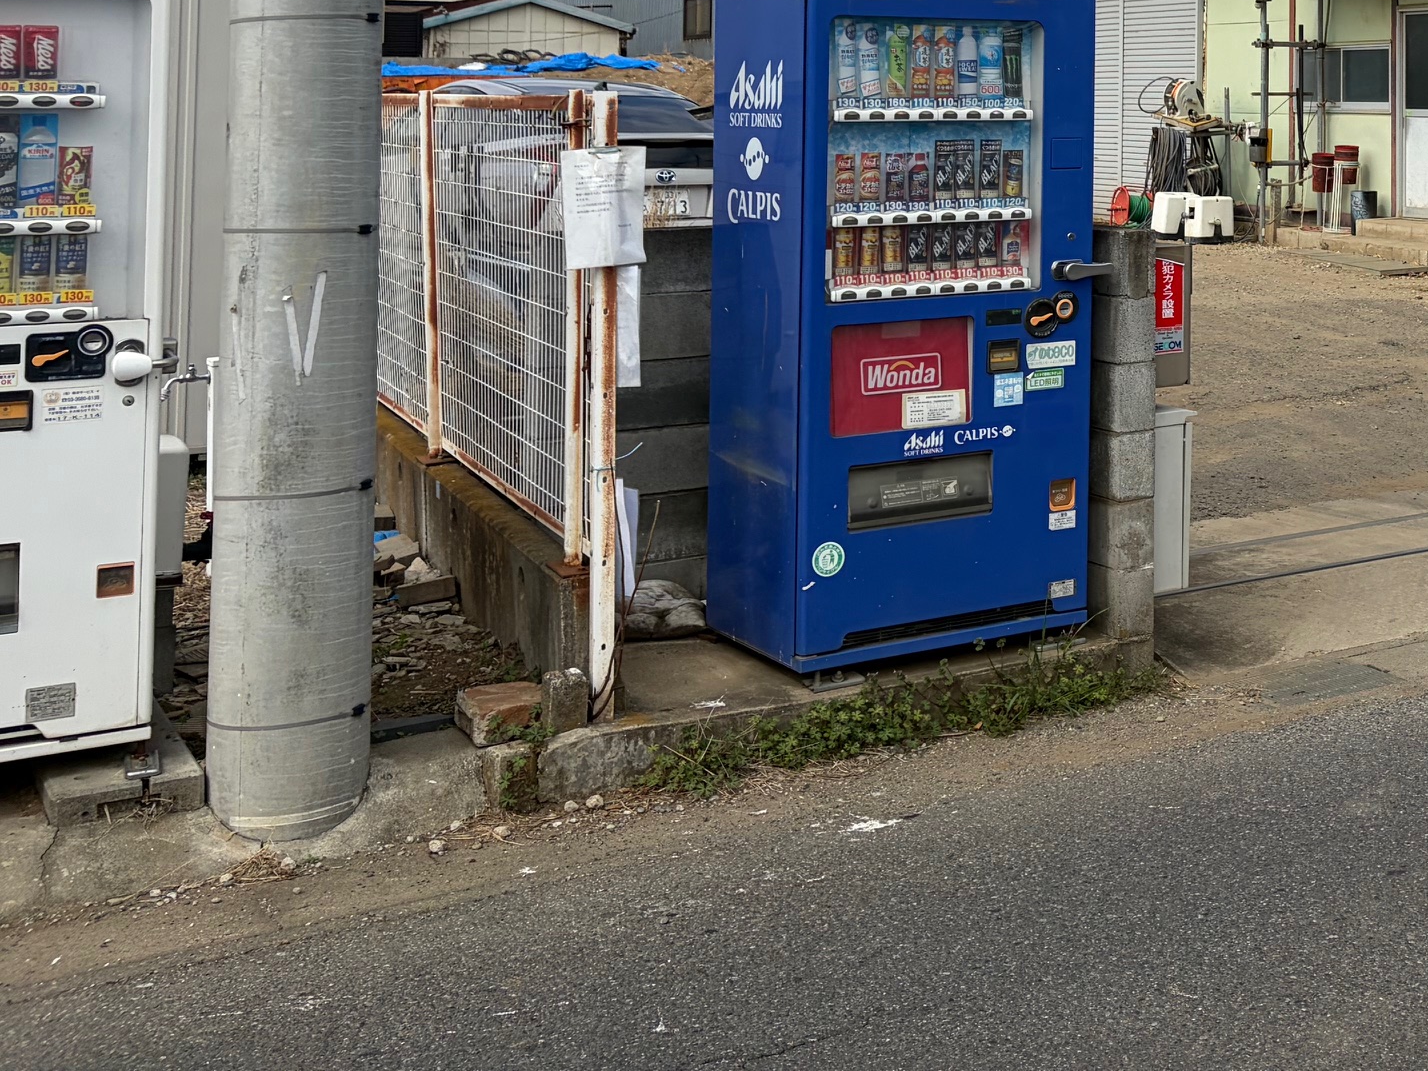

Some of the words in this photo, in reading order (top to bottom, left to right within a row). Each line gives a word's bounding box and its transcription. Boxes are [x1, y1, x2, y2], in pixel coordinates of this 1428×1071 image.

[37, 34, 55, 69] Mets
[729, 59, 784, 110] Asahi
[729, 112, 750, 127] SOFT
[751, 113, 782, 128] DRINKS
[727, 188, 781, 224] CALPIS
[1154, 340, 1181, 351] SECOM
[867, 361, 936, 389] Wonda
[904, 430, 944, 451] Asahi
[954, 427, 998, 445] CALPIS
[921, 447, 944, 455] DRINKS
